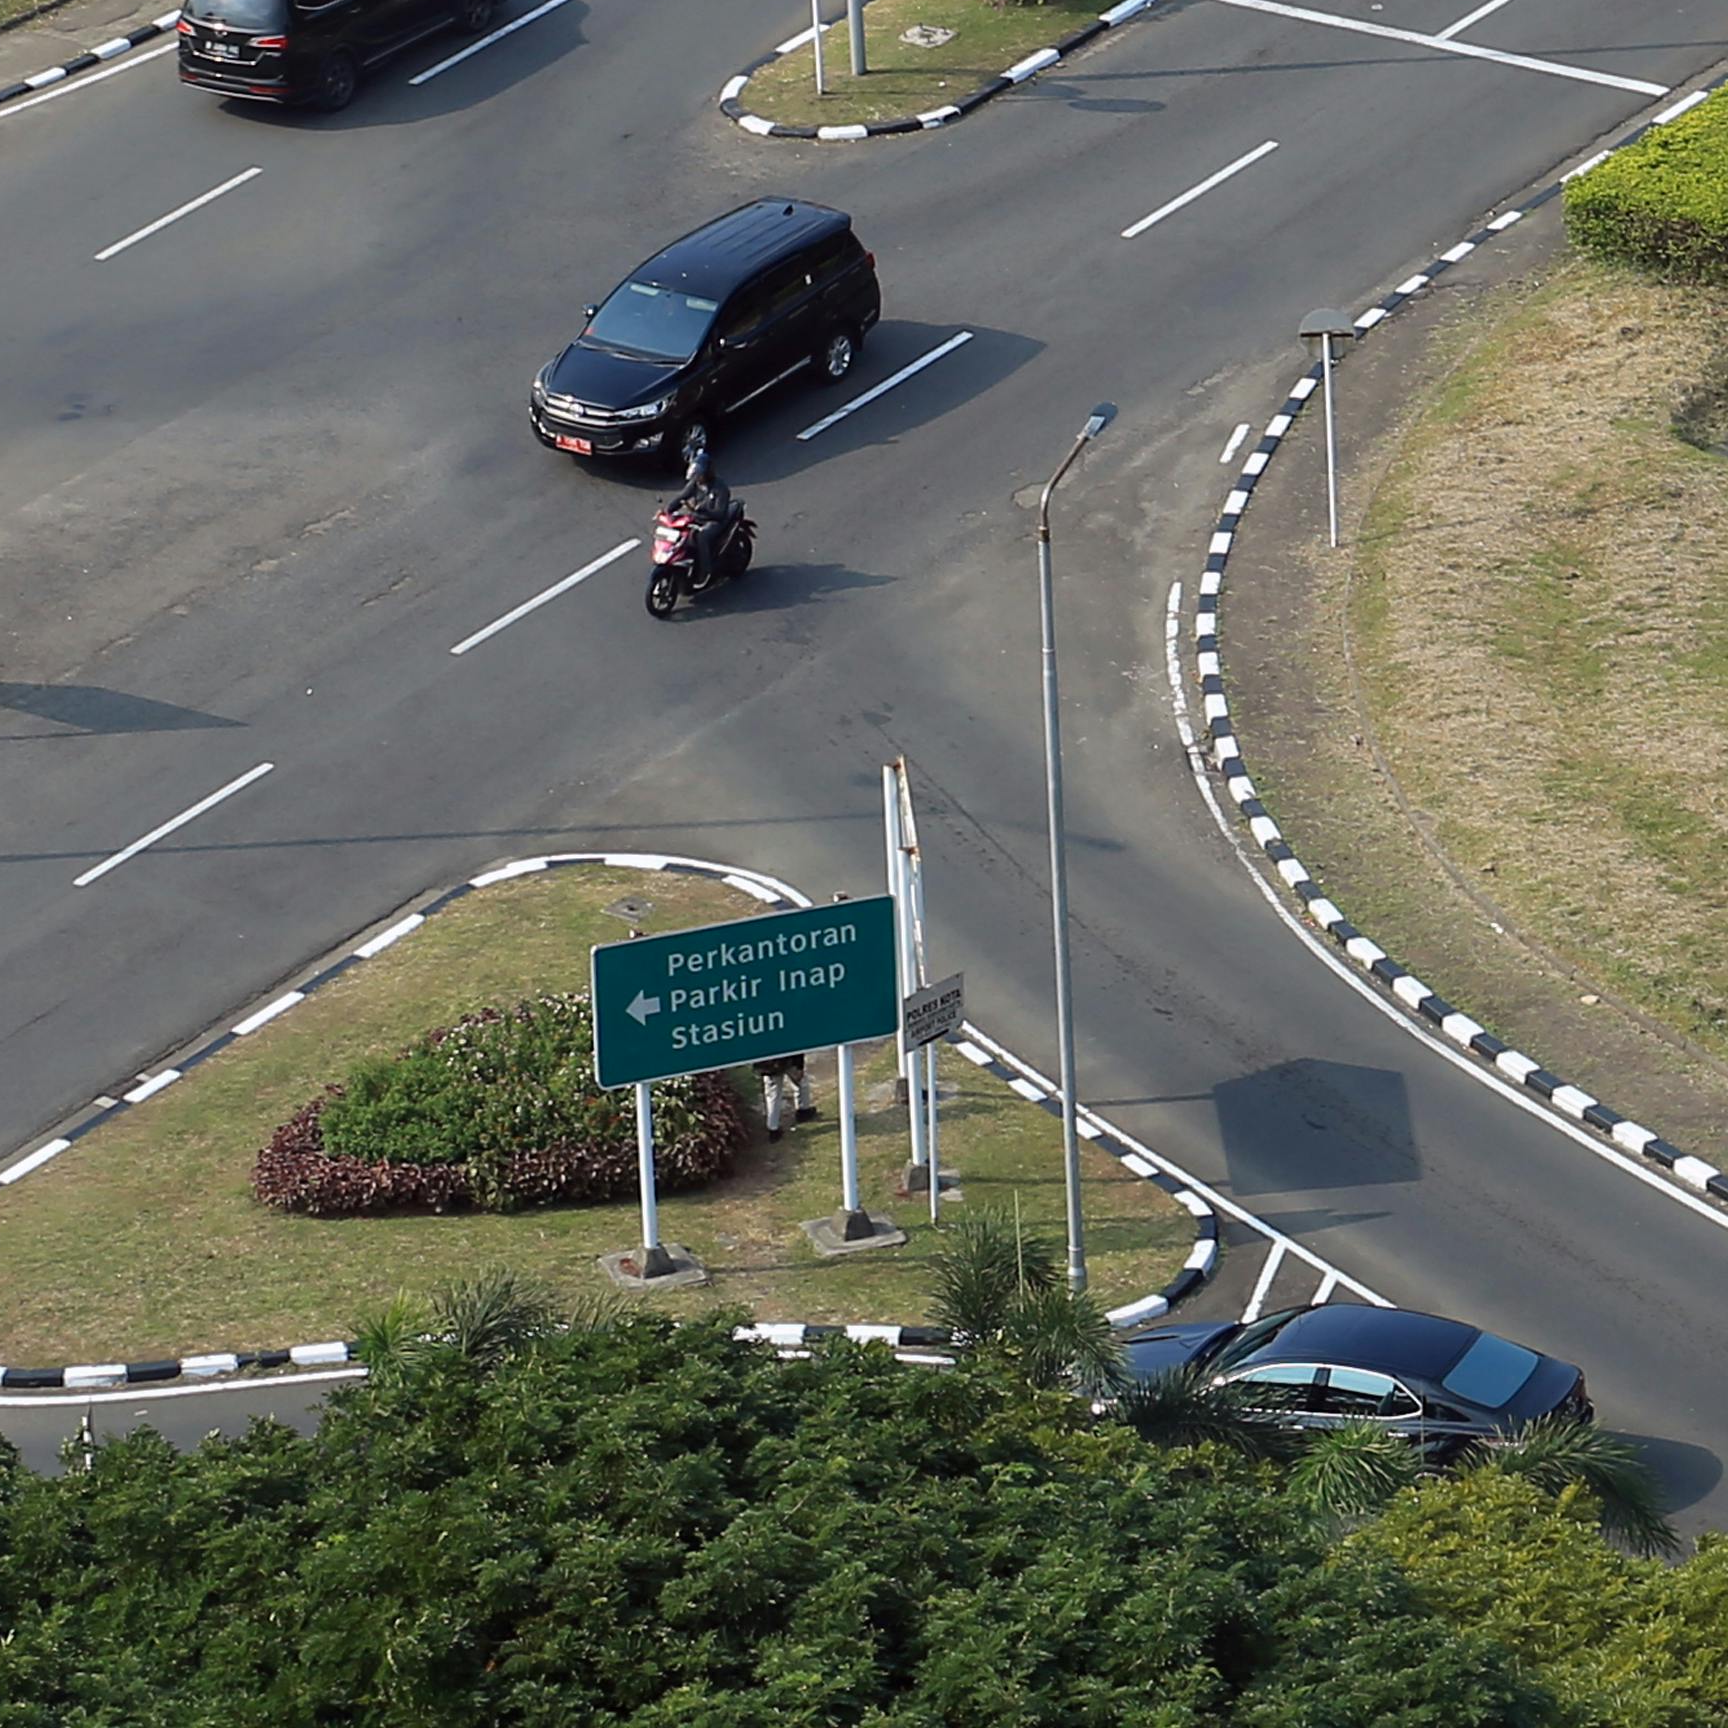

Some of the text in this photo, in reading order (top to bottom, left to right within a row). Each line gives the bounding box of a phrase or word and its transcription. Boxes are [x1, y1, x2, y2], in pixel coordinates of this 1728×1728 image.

[668, 923, 857, 976] Perkantoran
[670, 962, 845, 1012] Parkir Inap
[672, 1010, 784, 1049] Stasiun
